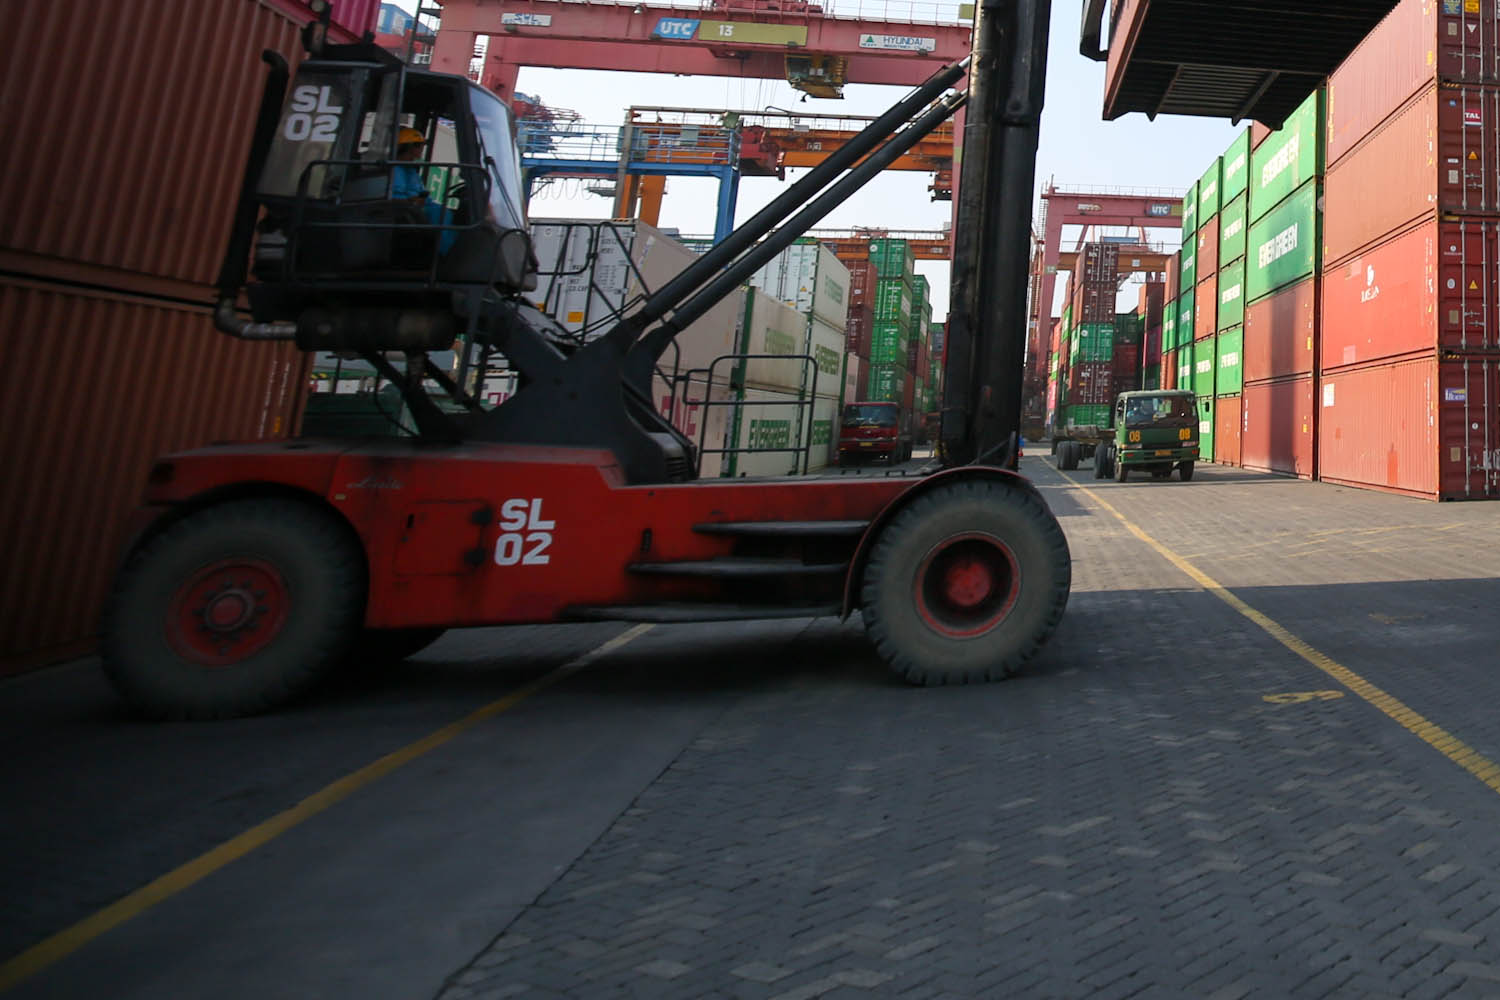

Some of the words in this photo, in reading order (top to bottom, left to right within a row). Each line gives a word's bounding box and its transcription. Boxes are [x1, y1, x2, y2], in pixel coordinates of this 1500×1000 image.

[660, 21, 692, 37] UTC
[719, 24, 734, 37] 13
[883, 36, 923, 45] HYUNDAI
[291, 85, 343, 114] SL
[285, 113, 340, 142] 02
[1152, 205, 1168, 214] UTC
[499, 498, 556, 531] SL
[494, 531, 552, 566] 02
